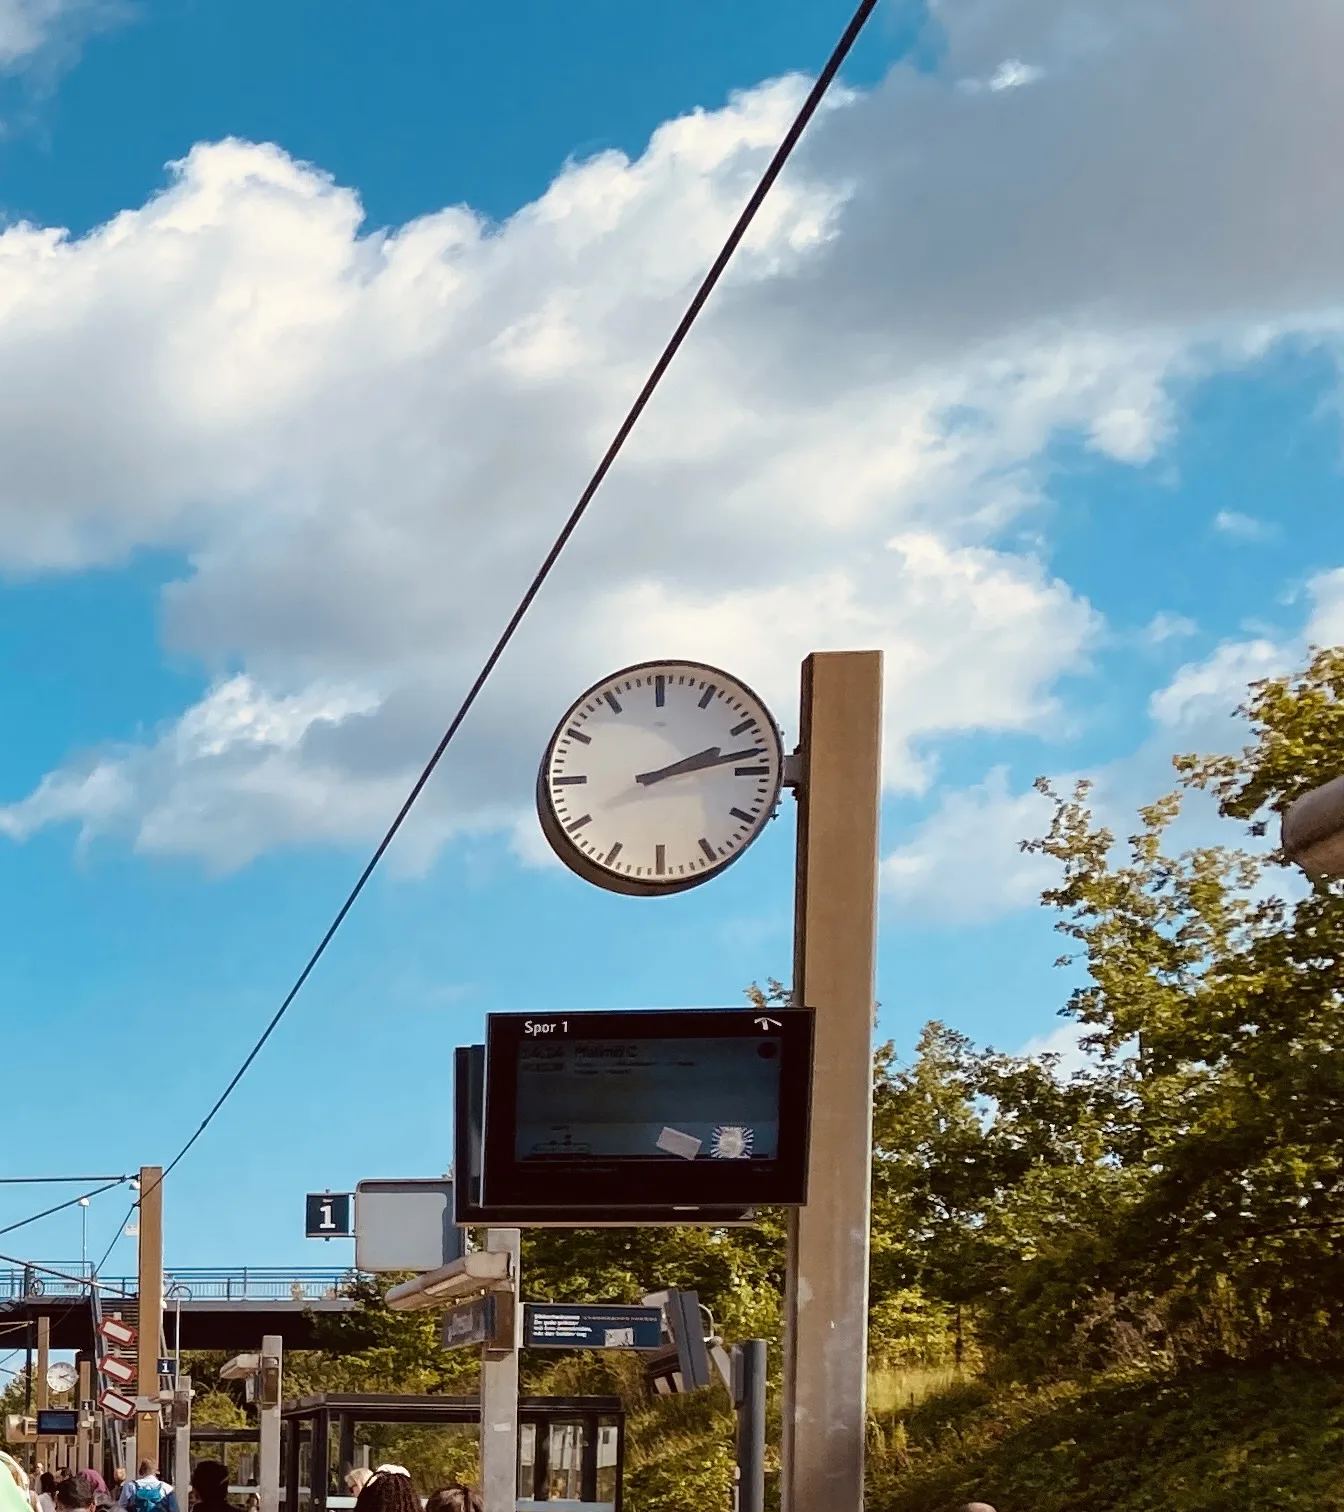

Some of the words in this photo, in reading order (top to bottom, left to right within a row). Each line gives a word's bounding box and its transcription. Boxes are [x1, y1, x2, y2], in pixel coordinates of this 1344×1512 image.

[524, 1019, 557, 1037] Spor
[561, 1020, 569, 1033] 1
[319, 1204, 336, 1229] 1
[161, 1362, 170, 1373] 1
